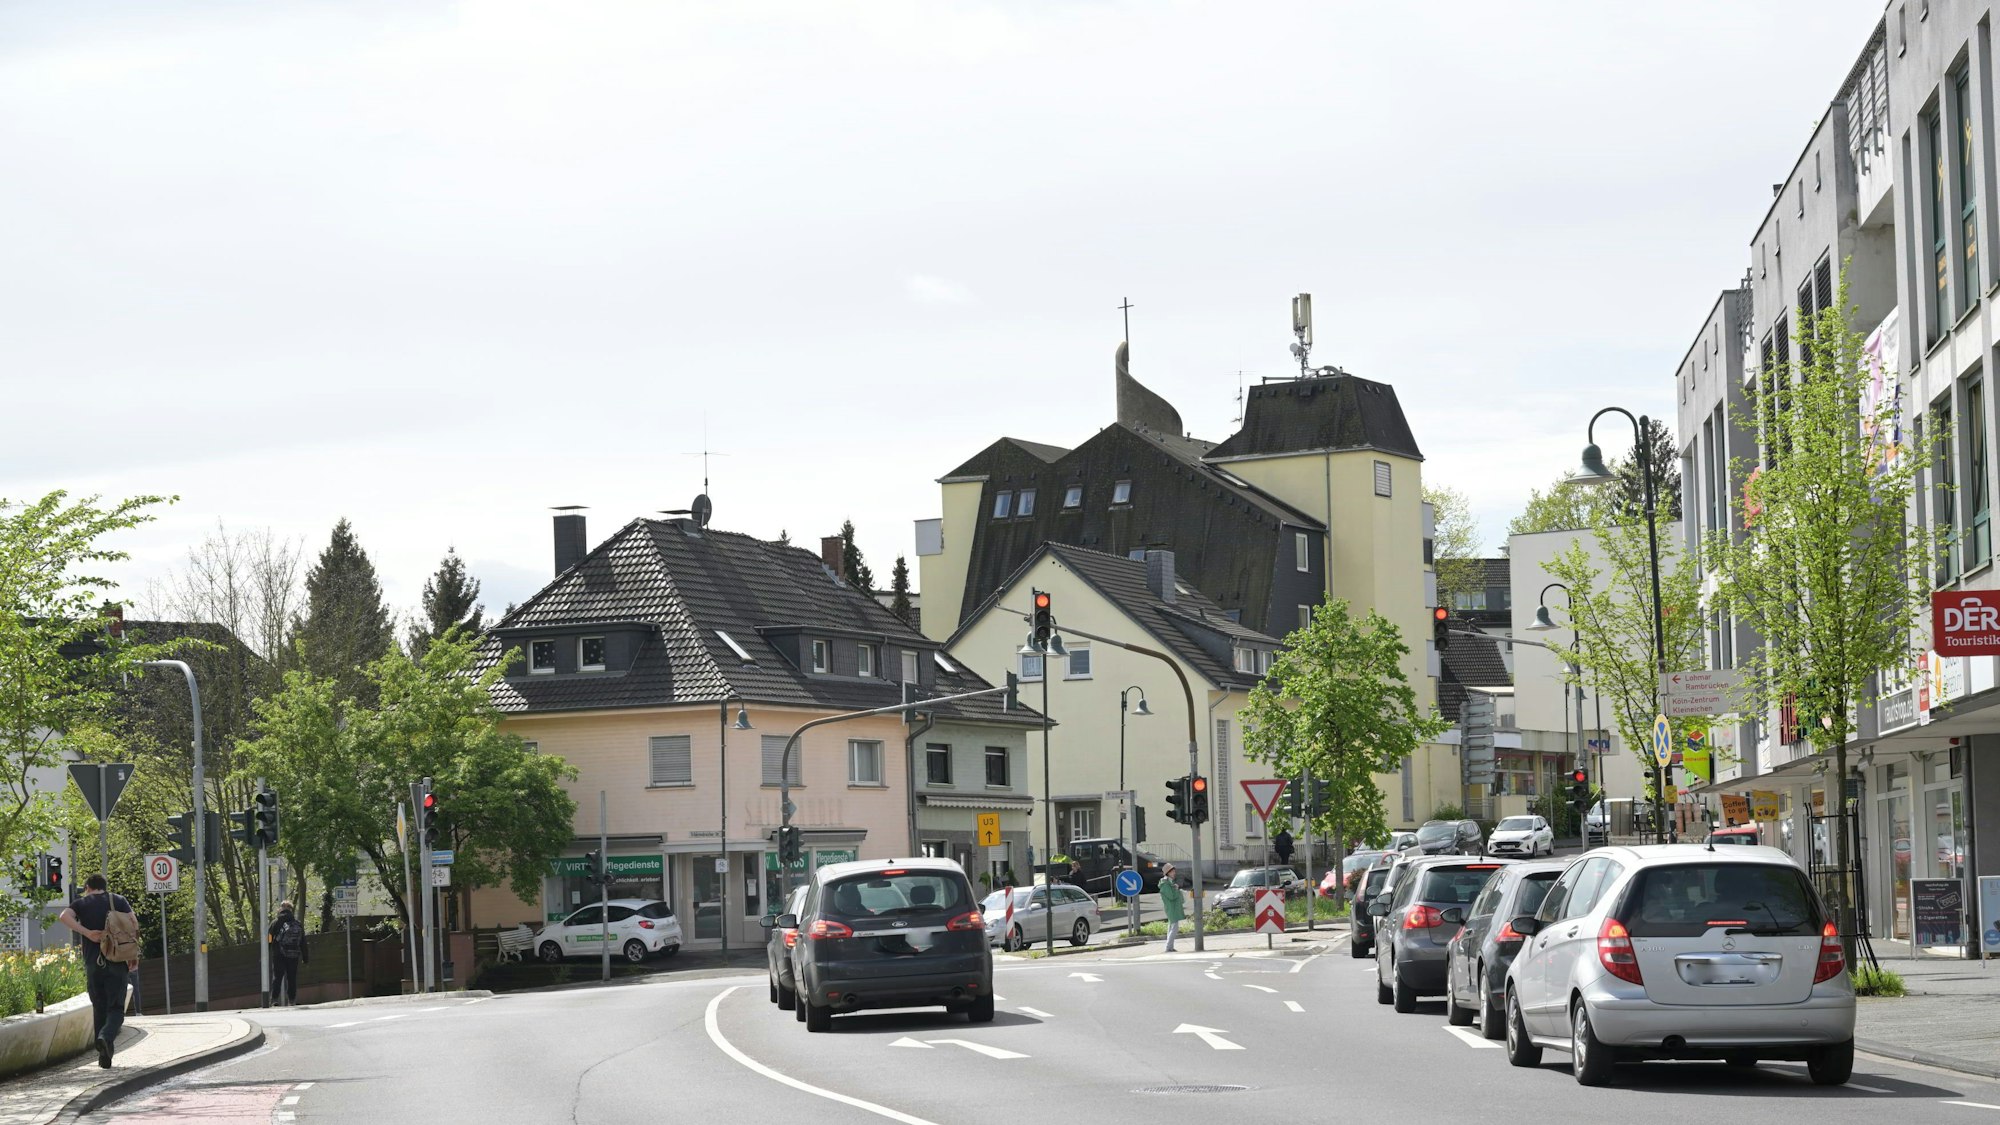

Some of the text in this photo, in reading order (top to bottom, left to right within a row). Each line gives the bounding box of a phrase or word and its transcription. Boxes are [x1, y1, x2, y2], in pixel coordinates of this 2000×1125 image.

[1944, 606, 2000, 631] DER
[1945, 635, 2000, 646] Touristik
[1672, 696, 1719, 704] Köln-Zentrum
[156, 863, 167, 875] 30
